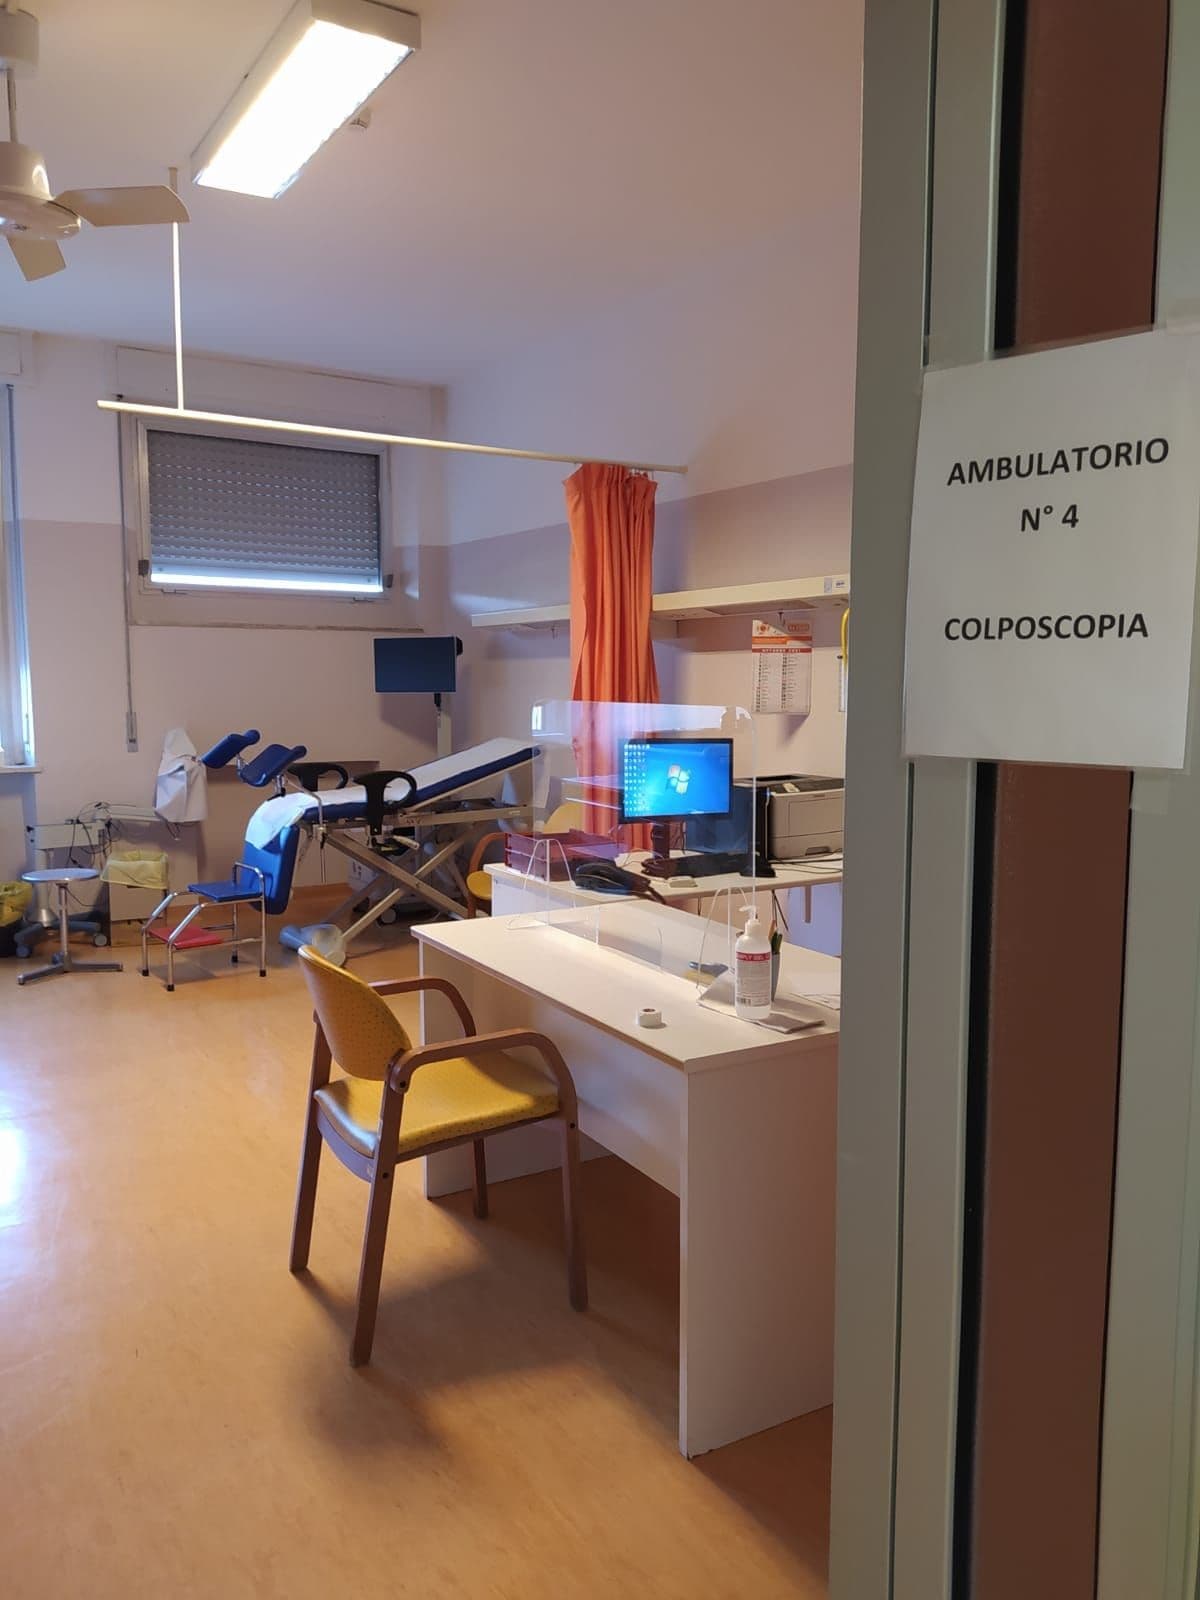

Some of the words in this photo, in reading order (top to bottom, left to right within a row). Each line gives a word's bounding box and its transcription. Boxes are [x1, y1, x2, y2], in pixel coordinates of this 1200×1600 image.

[946, 437, 1169, 486] AMBULATORIO
[1020, 505, 1053, 532] N°
[1061, 504, 1079, 528] 4
[944, 613, 1149, 640] COLPOSCOPIA
